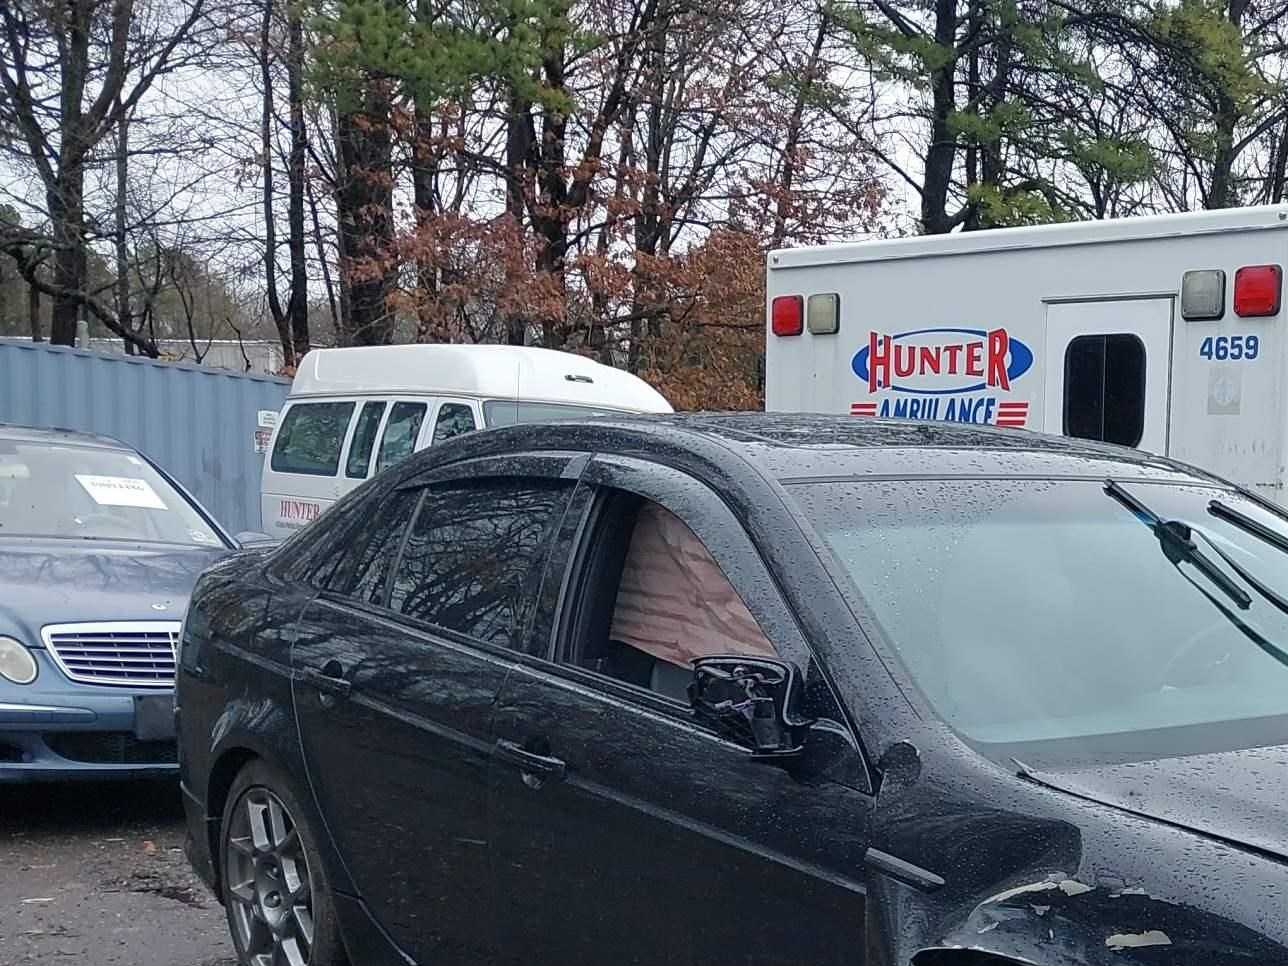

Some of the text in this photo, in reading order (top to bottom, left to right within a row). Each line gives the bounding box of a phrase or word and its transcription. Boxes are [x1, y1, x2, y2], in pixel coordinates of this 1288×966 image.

[868, 328, 1010, 394] HUNTER
[1199, 335, 1259, 361] 4659
[879, 397, 996, 424] AMBULANCE
[280, 500, 320, 521] HUNTER
